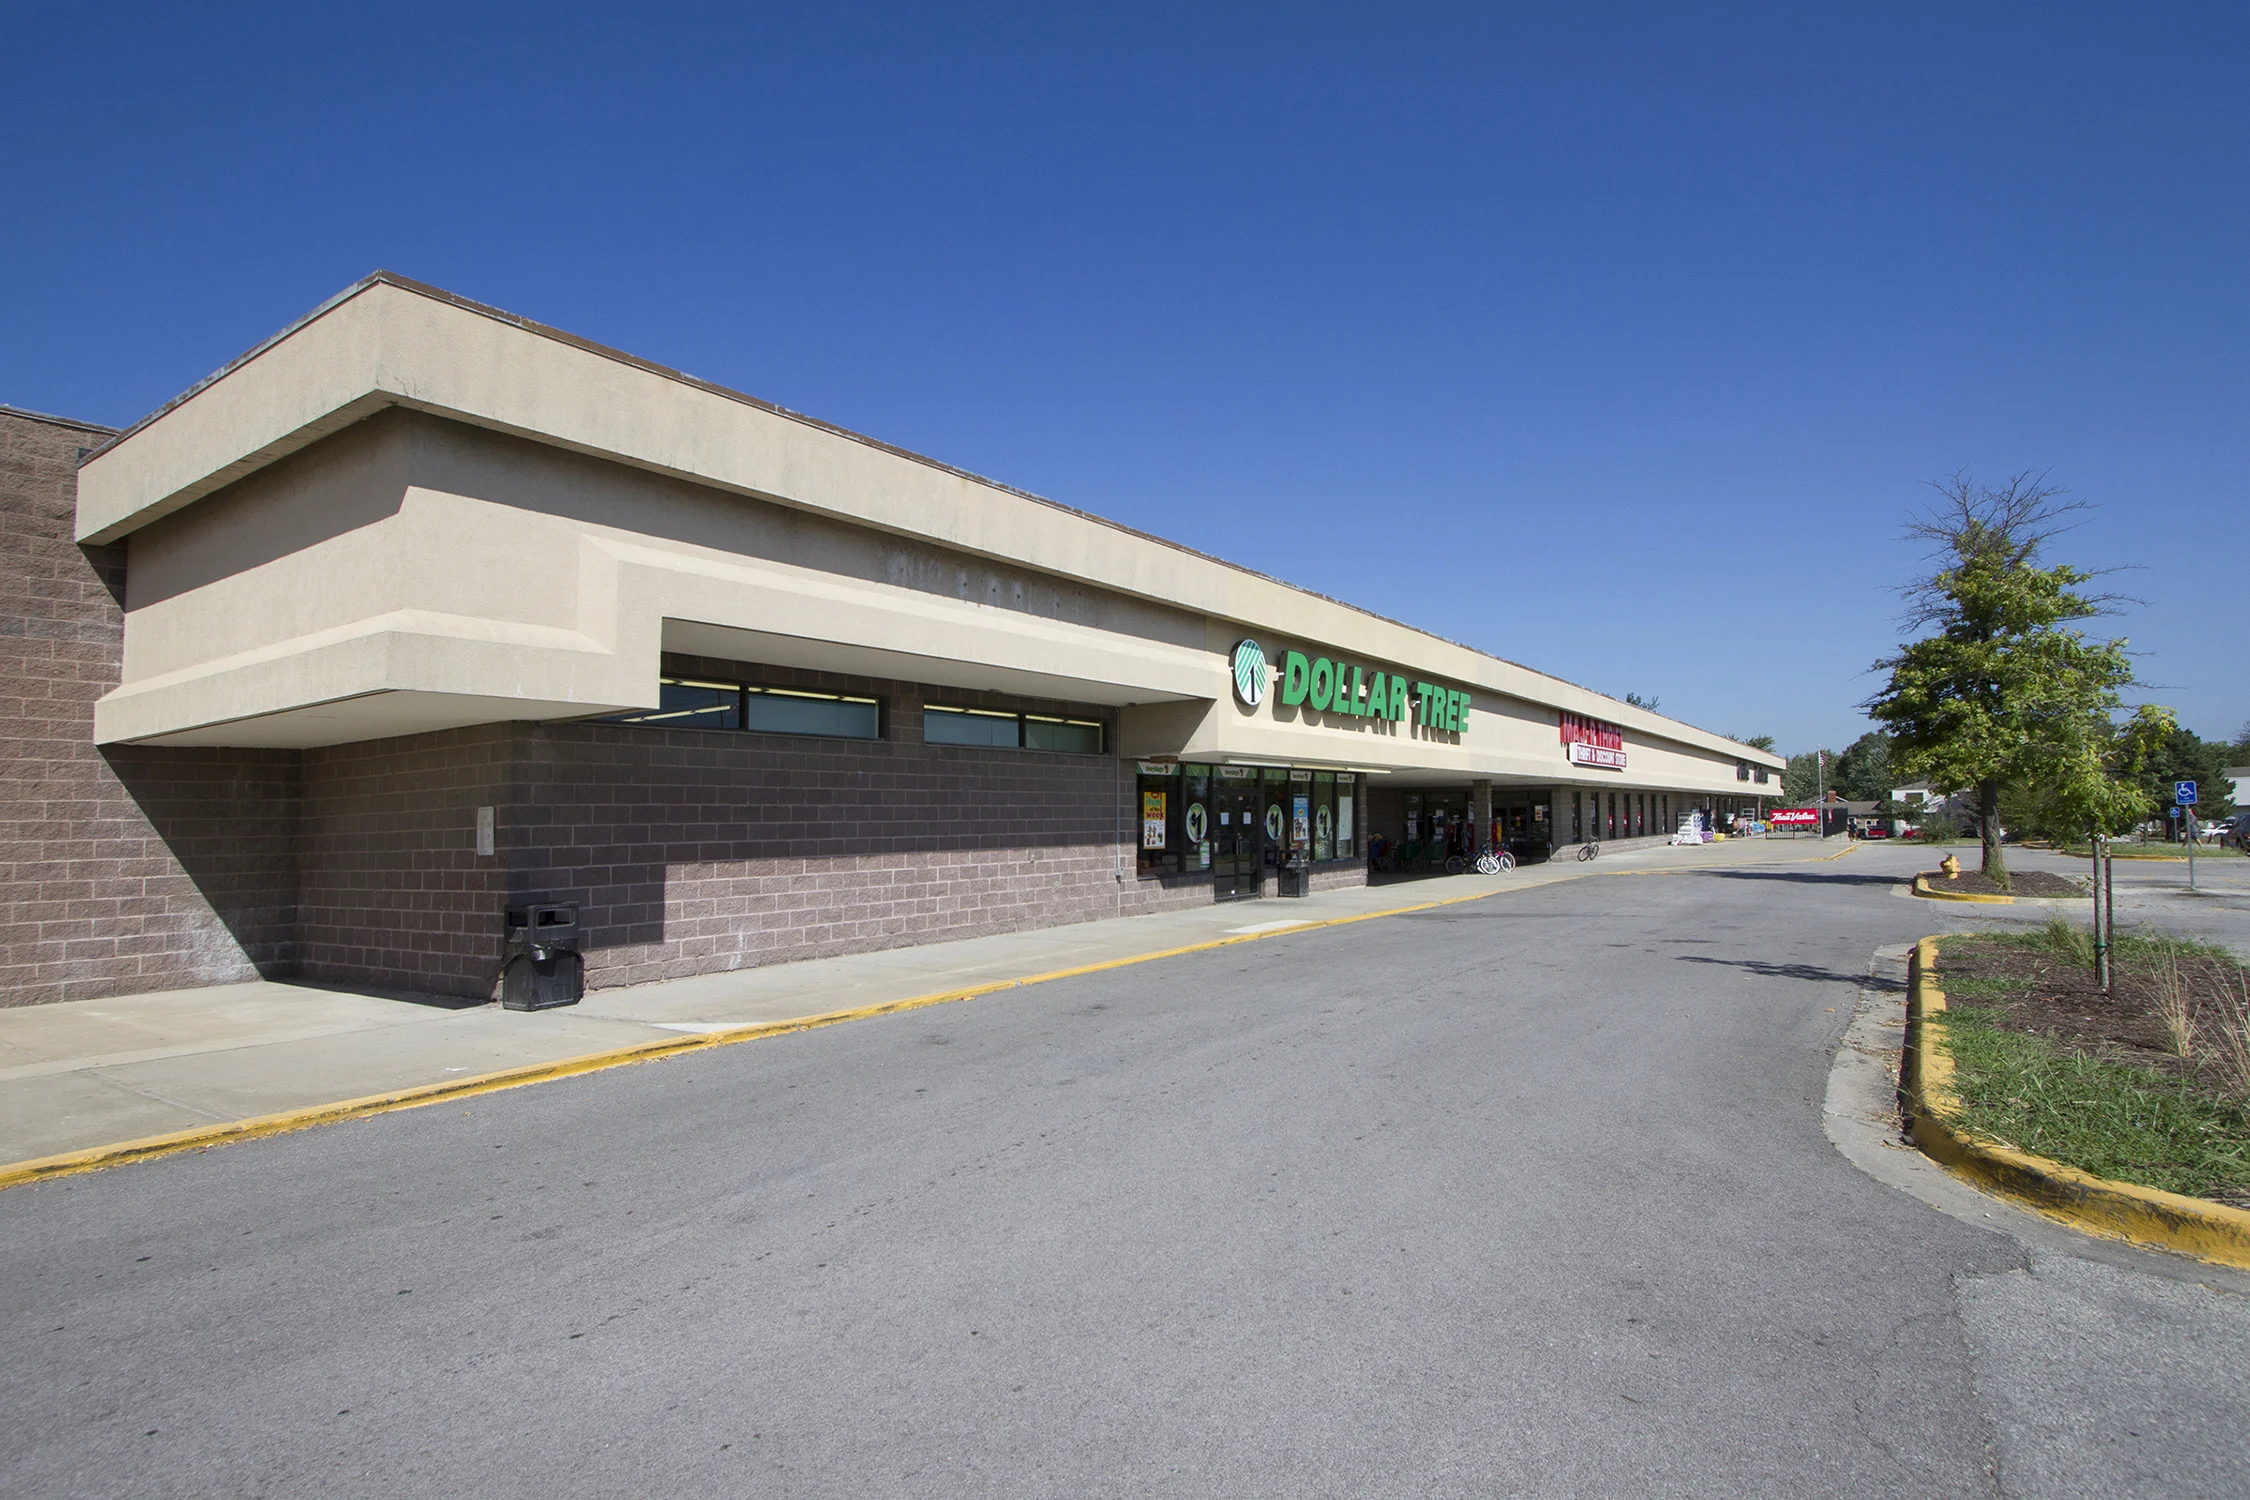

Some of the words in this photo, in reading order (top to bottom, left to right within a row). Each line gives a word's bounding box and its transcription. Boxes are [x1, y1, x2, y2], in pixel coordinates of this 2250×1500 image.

[1282, 650, 1408, 722] DOLLAR
[1417, 681, 1471, 733] TREE
[1146, 812, 1164, 820] week
[1191, 811, 1202, 836] $1
[1771, 812, 1790, 821] True
[1786, 811, 1816, 821] Value
